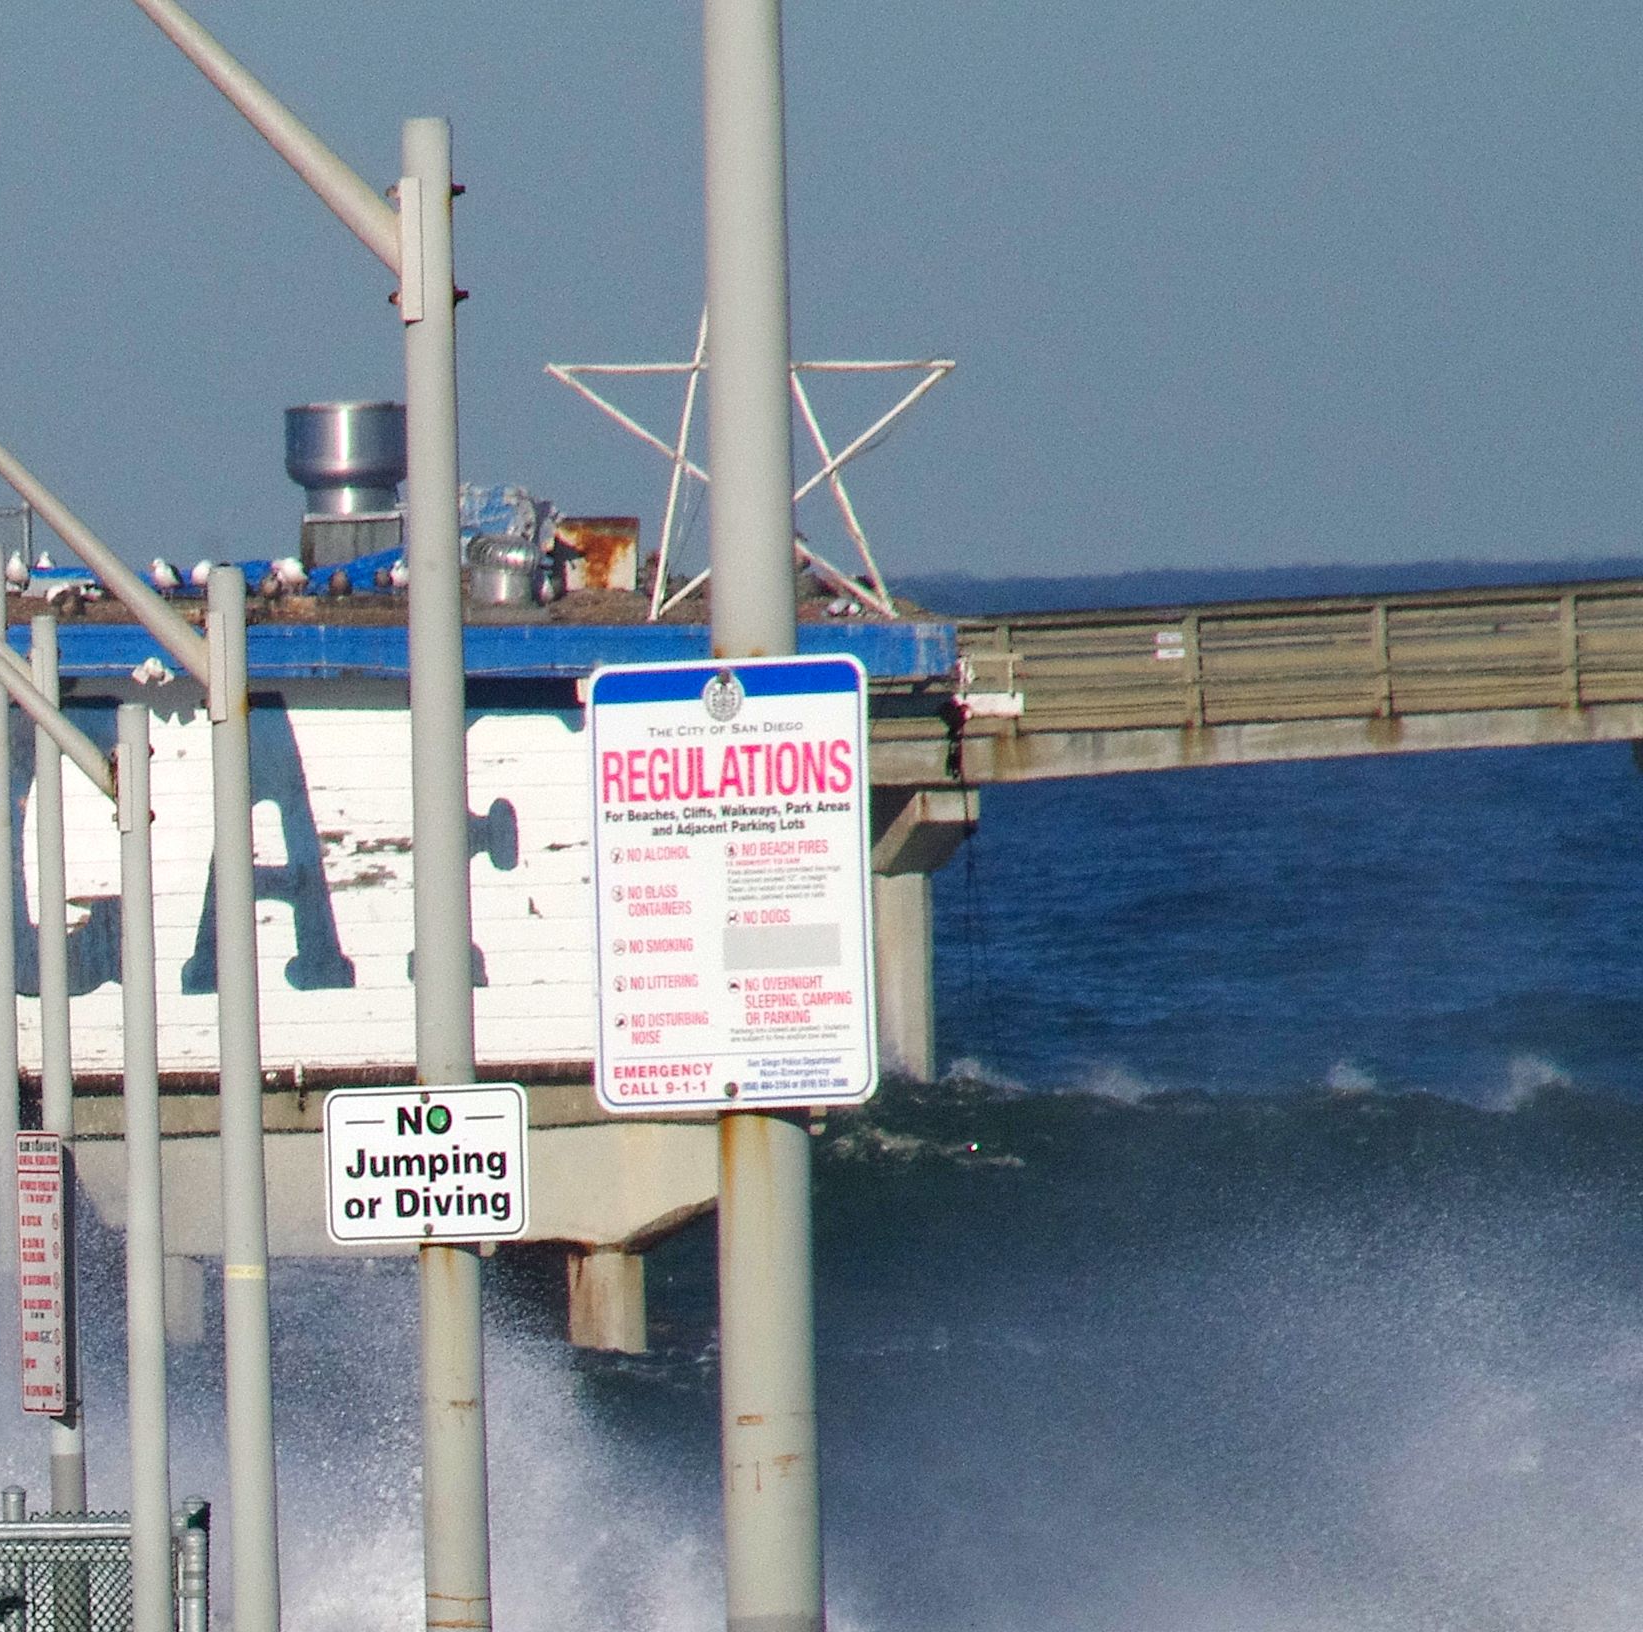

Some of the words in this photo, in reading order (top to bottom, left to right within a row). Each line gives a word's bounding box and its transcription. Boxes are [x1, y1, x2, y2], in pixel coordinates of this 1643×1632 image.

[648, 728, 673, 737] THE
[678, 726, 705, 736] CITY
[710, 726, 725, 735] OF
[732, 723, 758, 734] SAN
[764, 721, 803, 733] DIEGO
[603, 739, 853, 804] REGULATIONS
[605, 811, 623, 823] For
[628, 810, 679, 822] Beaches,
[683, 806, 716, 819] Cliffs,
[721, 805, 780, 818] Walkways,
[786, 802, 811, 814] Park
[817, 800, 850, 812] Areas
[652, 825, 673, 836] and
[676, 822, 728, 837] Adjacent
[732, 819, 775, 833] Parking
[780, 818, 805, 830] Lots
[627, 849, 641, 862] NO
[644, 846, 690, 861] ALCOHOL
[742, 843, 756, 856] NO
[760, 841, 795, 855] BEACH
[798, 840, 828, 854] FIRES
[628, 886, 642, 899] NO
[628, 901, 692, 917] CONTAINERS
[743, 911, 757, 924] NO
[761, 909, 791, 924] DOGS
[629, 940, 644, 953] NO
[646, 938, 693, 952] SMOKING
[630, 976, 644, 990] NO
[648, 974, 699, 989] LITTERING
[745, 978, 759, 991] NO
[763, 975, 822, 990] OVERNIGHT
[745, 994, 800, 1008] SLEEPING,
[802, 991, 852, 1006] CAMPING
[631, 1014, 646, 1027] NO
[648, 1011, 709, 1026] DISTURBING
[746, 1012, 760, 1025] OR
[764, 1010, 811, 1024] PARKING
[631, 1030, 661, 1045] NOISE
[614, 1063, 713, 1079] EMERGENCY
[619, 1083, 659, 1096] CALL
[666, 1080, 707, 1094] 9-1-1
[397, 1105, 453, 1136] NO
[346, 1145, 507, 1183] Jumping
[344, 1196, 382, 1220] or
[395, 1186, 511, 1222] Diving
